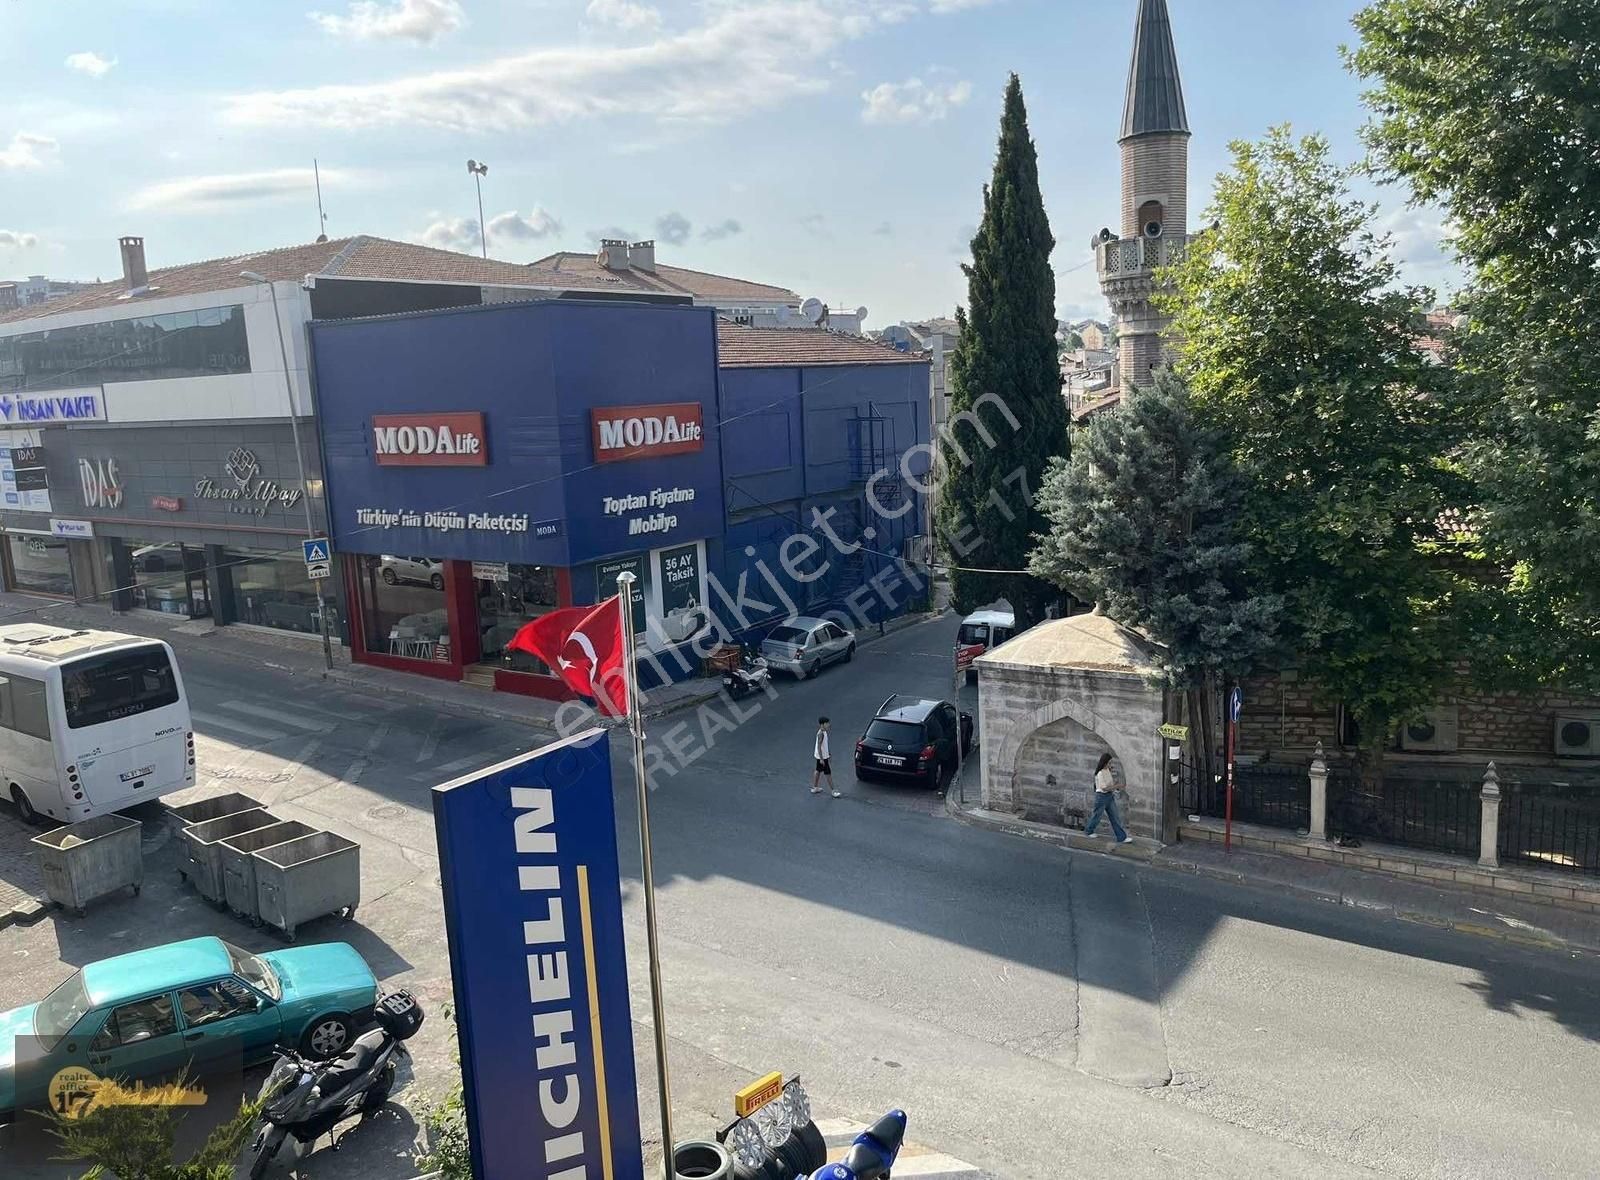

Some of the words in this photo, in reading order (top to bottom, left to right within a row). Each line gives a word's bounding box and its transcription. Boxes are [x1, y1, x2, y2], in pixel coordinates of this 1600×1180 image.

[374, 425, 455, 454] MODA
[455, 432, 480, 454] Life
[598, 416, 680, 450] MODA
[680, 421, 701, 441] Life
[603, 493, 647, 515] Toptan
[649, 487, 695, 509] Fiyatına
[356, 509, 421, 529] Türkiye'nin
[424, 511, 464, 532] Düğün
[468, 512, 528, 534] Paketçisi
[536, 525, 557, 536] MODA
[628, 512, 677, 535] Mobilya
[665, 558, 678, 570] 36
[680, 554, 692, 566] AY
[666, 566, 694, 582] Taksit
[510, 786, 588, 1180] ICHELIN
